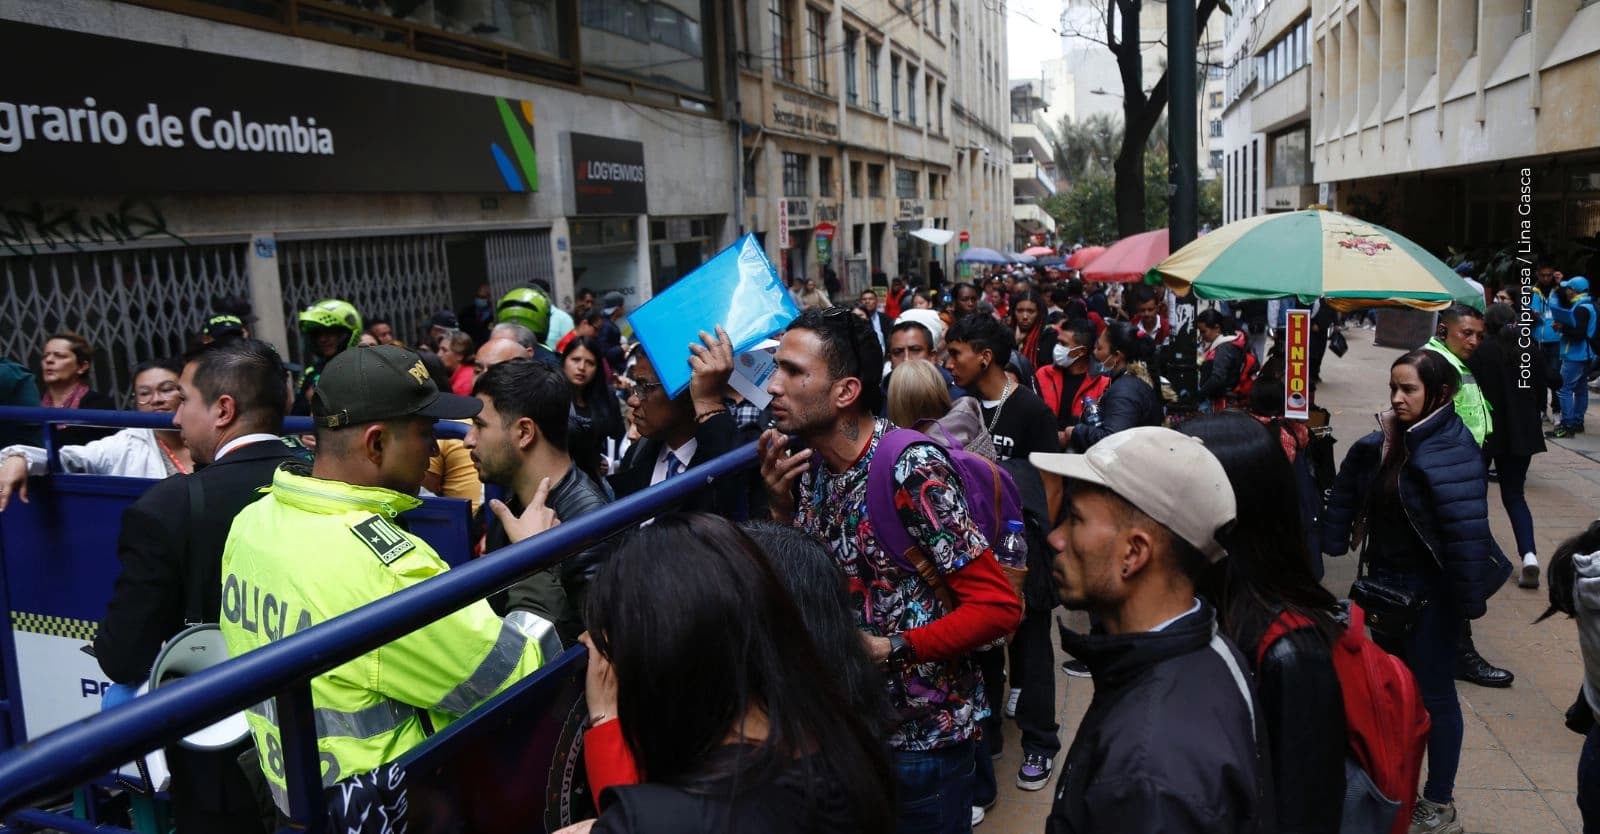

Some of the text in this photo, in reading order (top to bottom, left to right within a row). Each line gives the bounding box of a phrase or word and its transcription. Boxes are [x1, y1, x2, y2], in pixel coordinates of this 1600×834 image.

[0, 96, 334, 155] grario de Colombia
[1290, 315, 1305, 392] TINTO
